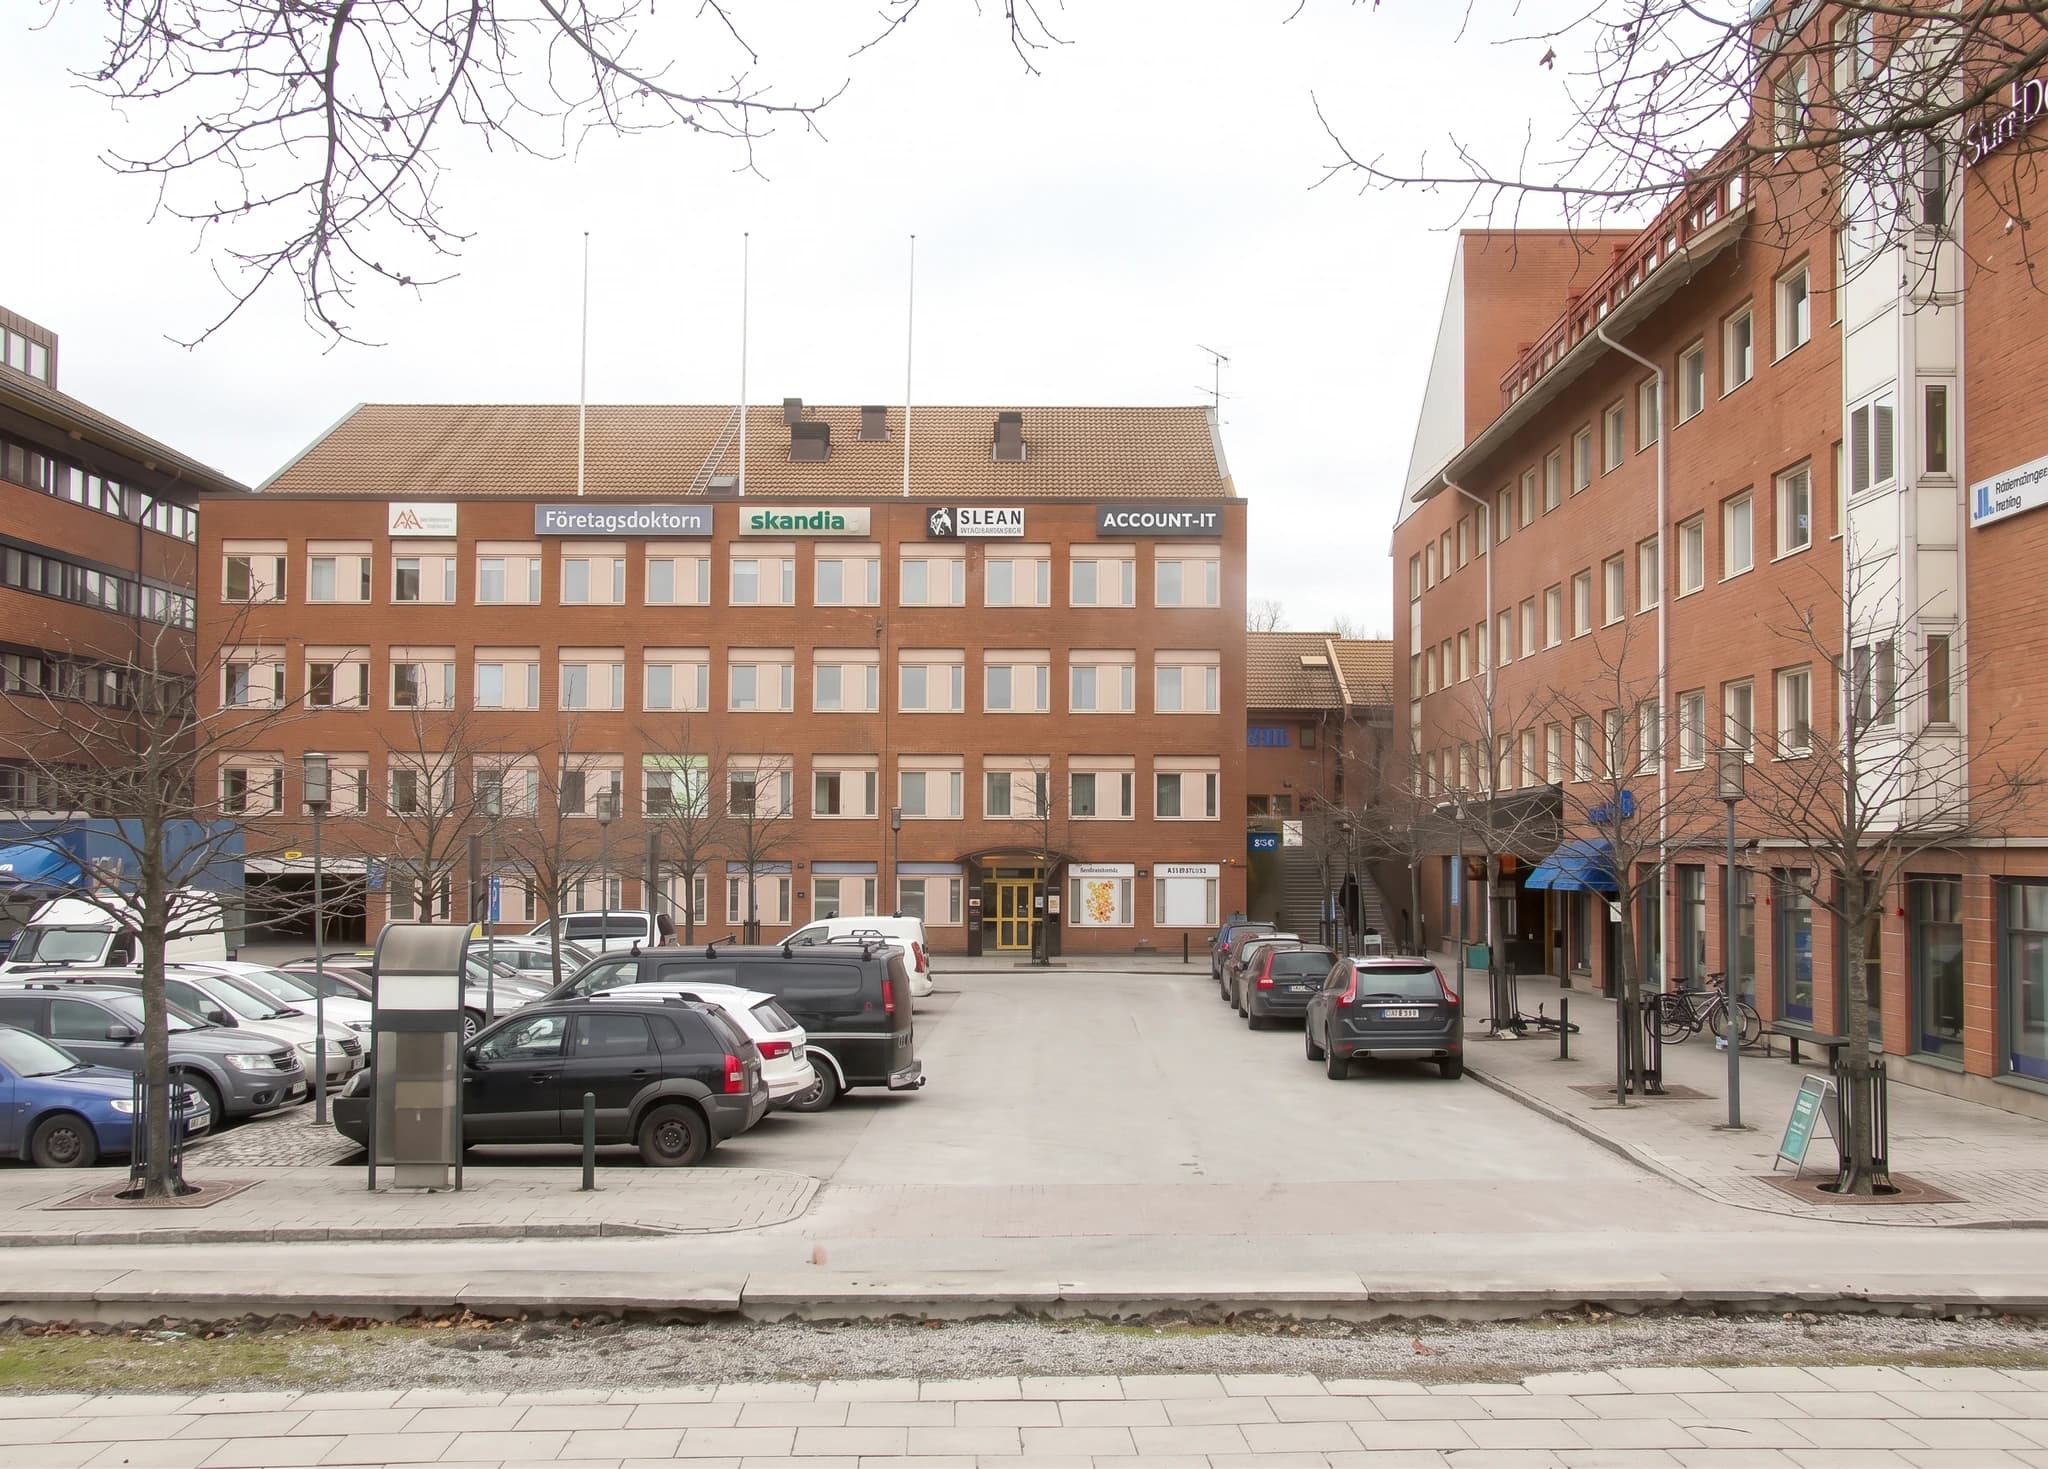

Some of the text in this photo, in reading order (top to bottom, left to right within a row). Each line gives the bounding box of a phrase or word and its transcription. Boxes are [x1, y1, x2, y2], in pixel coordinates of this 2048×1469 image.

[545, 510, 701, 532] Företagsdoktorn
[751, 511, 845, 530] skandia
[960, 510, 1021, 525] SLEAN
[1103, 512, 1217, 528] ACCOUNT-IT
